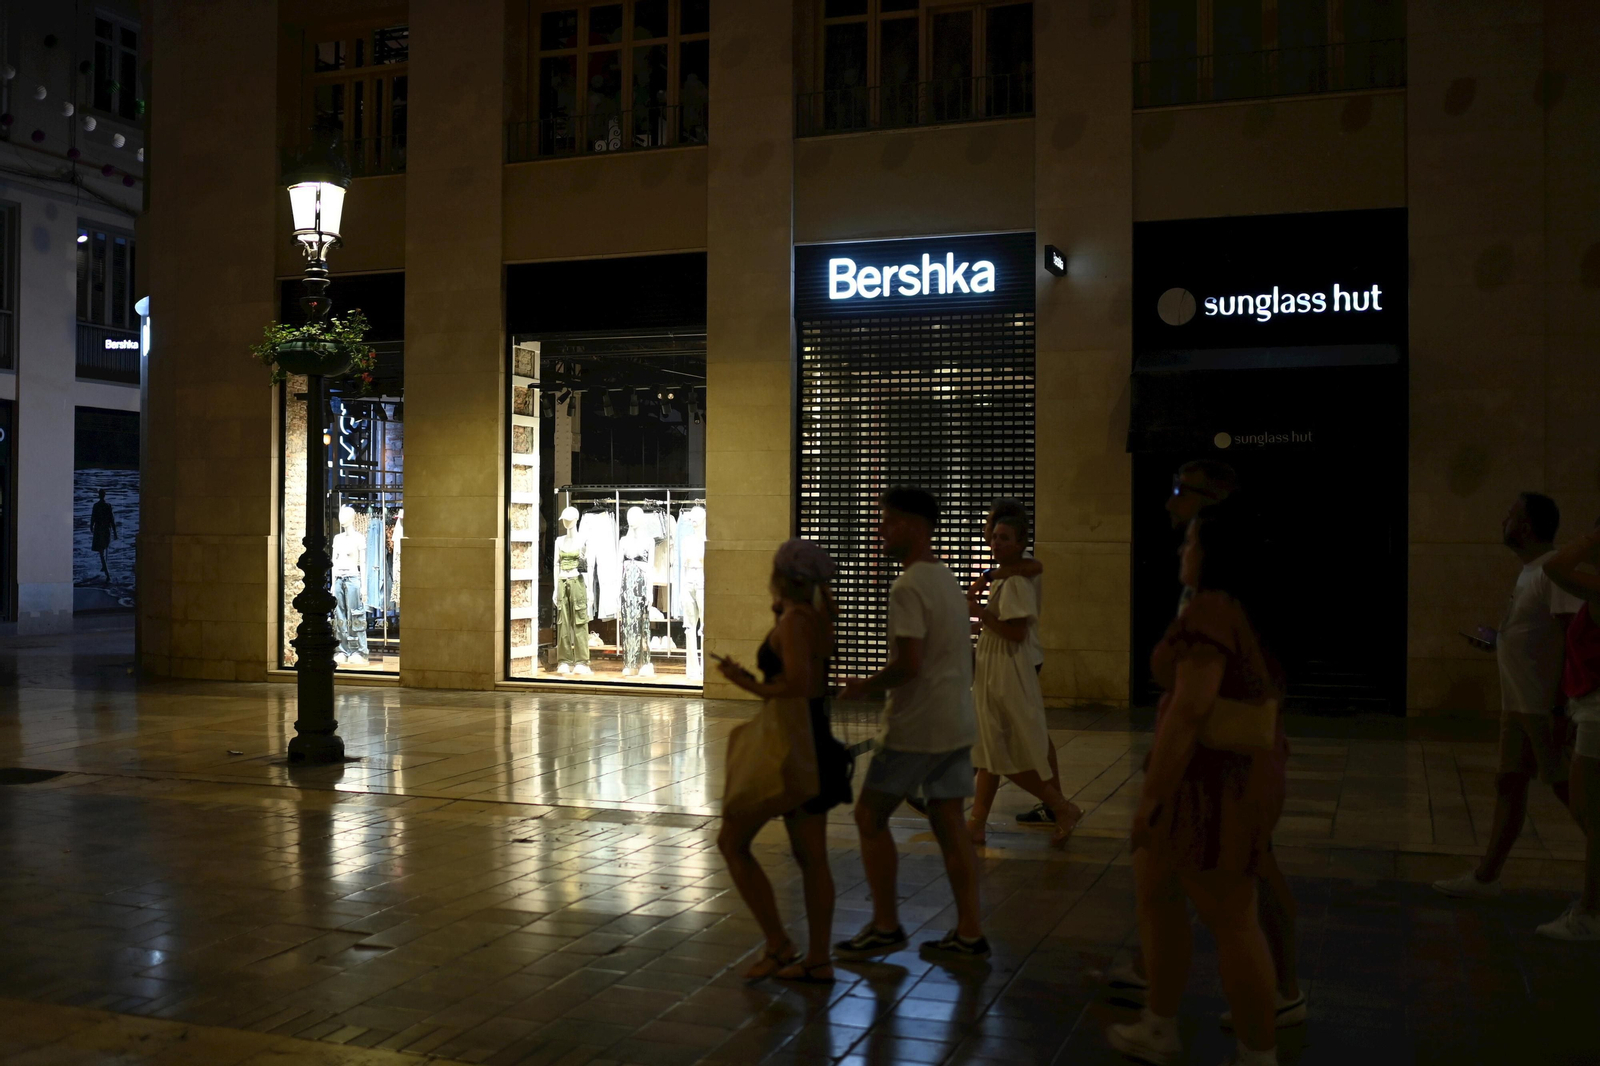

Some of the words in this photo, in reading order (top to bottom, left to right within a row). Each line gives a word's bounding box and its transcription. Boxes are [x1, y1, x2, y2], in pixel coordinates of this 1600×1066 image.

[828, 252, 996, 300] Bershka
[1204, 285, 1327, 323] sunglass
[1333, 283, 1383, 312] hut
[105, 339, 139, 350] Bershka
[1234, 431, 1289, 447] sunglass
[1291, 430, 1313, 443] hut
